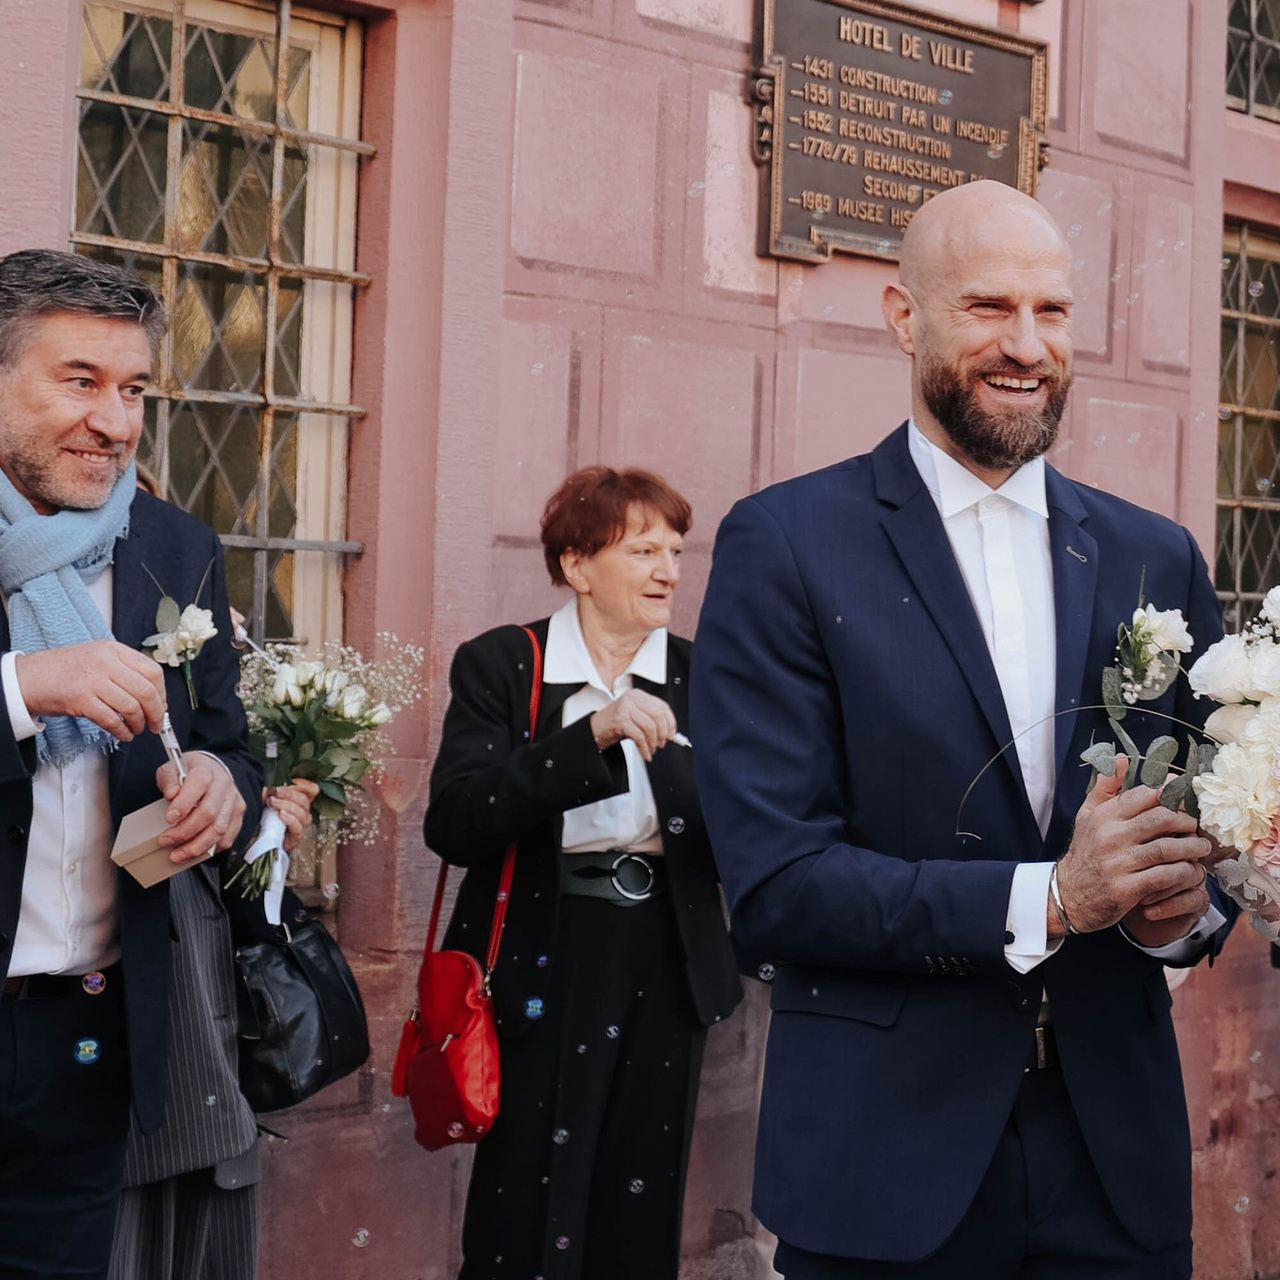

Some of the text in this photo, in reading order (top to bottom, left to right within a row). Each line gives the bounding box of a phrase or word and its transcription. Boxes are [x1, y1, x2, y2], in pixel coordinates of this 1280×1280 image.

[840, 16, 975, 74] HOTEL DE VILLE
[840, 65, 937, 103] CONSTRUCTION
[840, 91, 896, 120] DETRUIT
[901, 106, 927, 128] PAR
[932, 114, 951, 133] UN
[956, 119, 1009, 147] INCENDIE
[839, 118, 951, 159] RECONSTRUCTION
[864, 149, 964, 186] REHAUSSEMENT
[864, 175, 918, 203] SECOND
[838, 197, 885, 223] MUSEE
